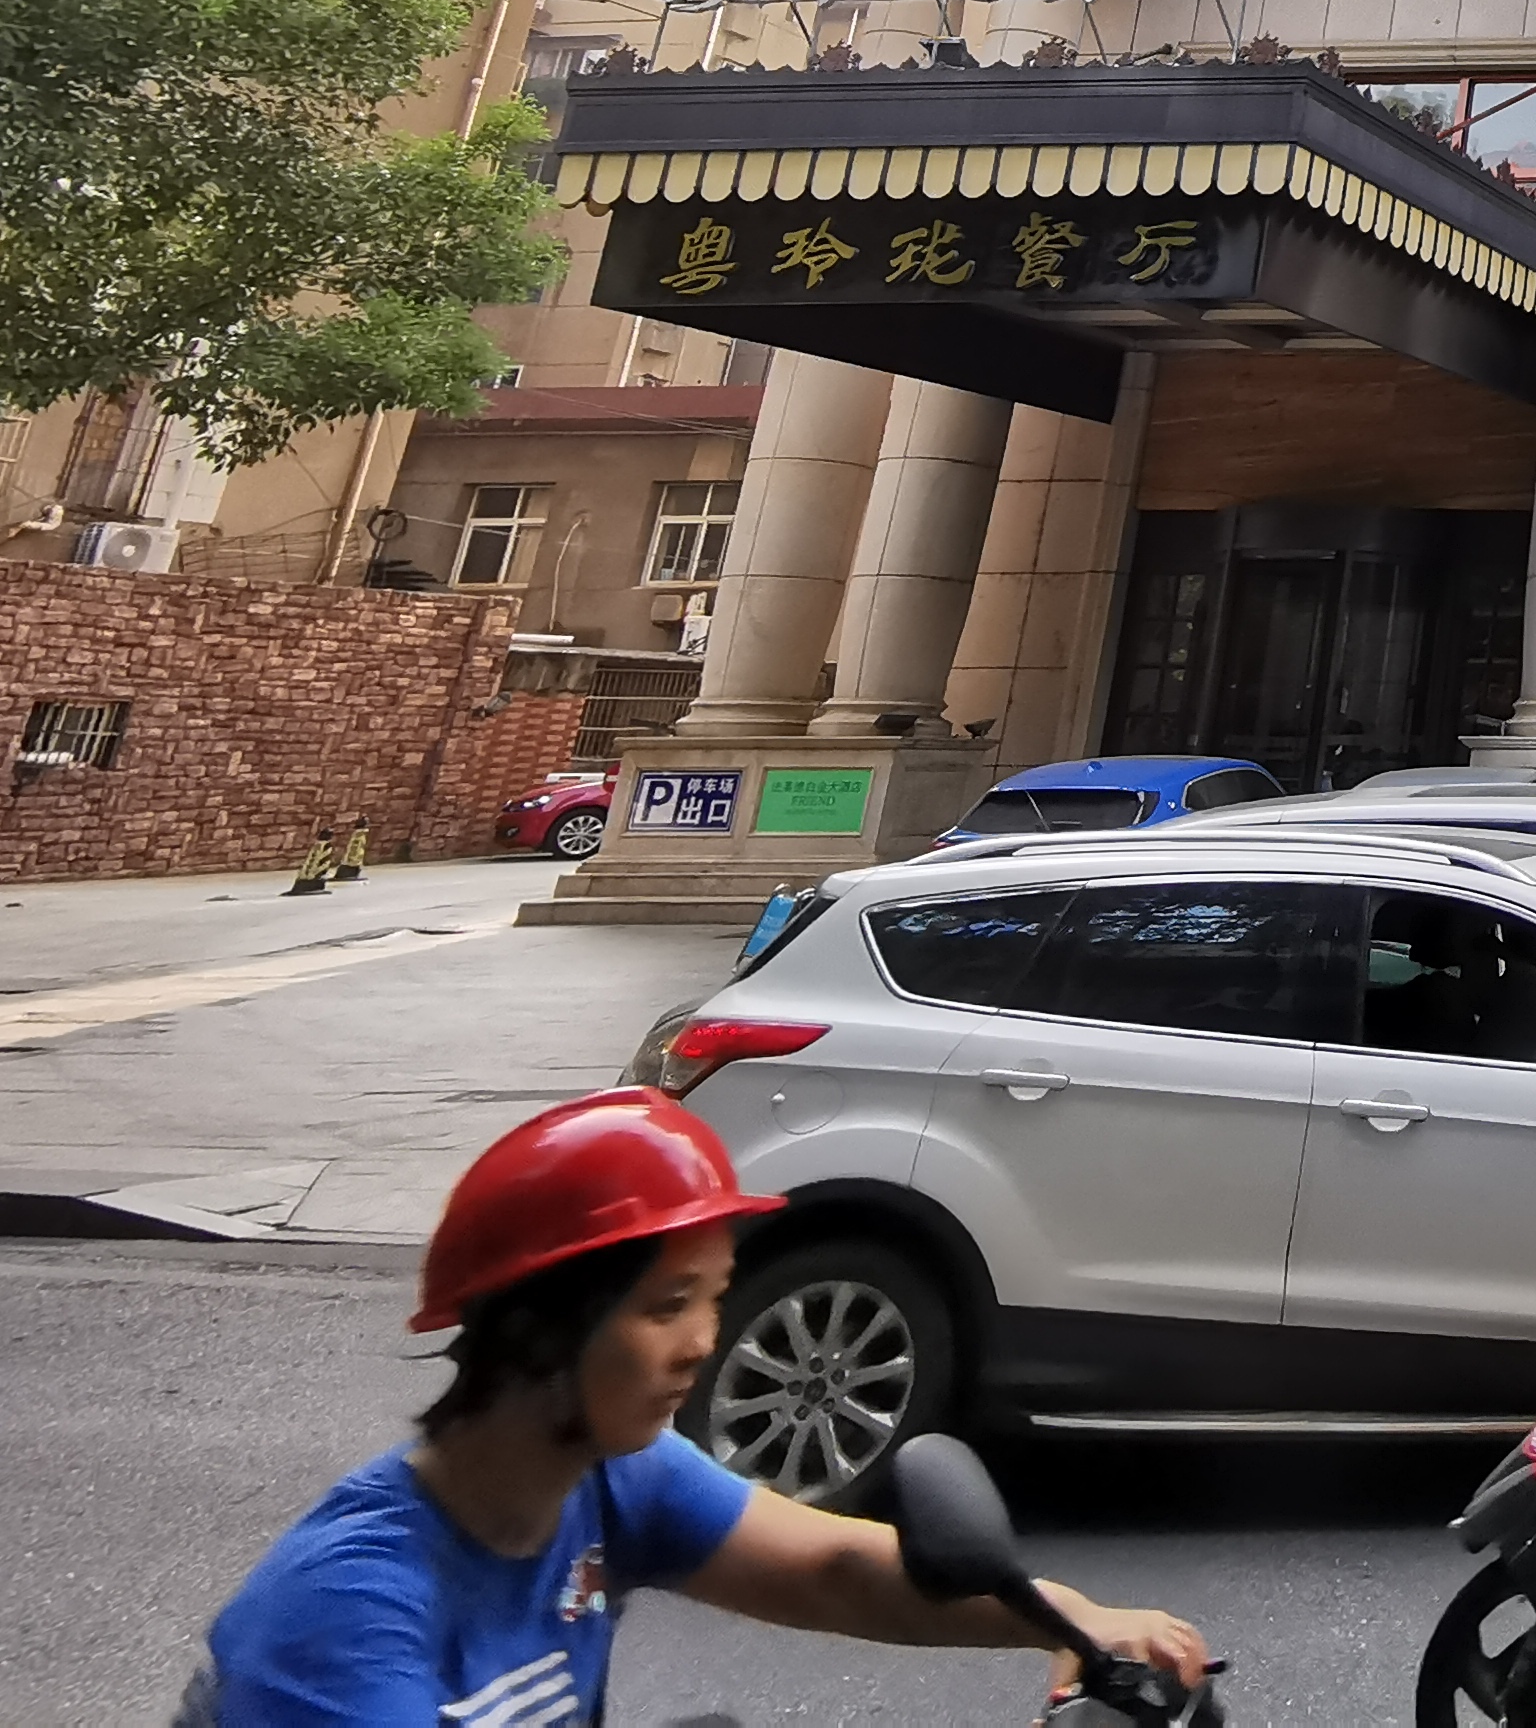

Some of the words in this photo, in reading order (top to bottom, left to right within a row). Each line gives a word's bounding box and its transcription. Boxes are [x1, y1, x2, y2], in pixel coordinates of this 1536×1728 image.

[659, 213, 1199, 295] 粤玲珑餐厅
[686, 777, 736, 794] 停车场
[676, 795, 732, 826] 出口
